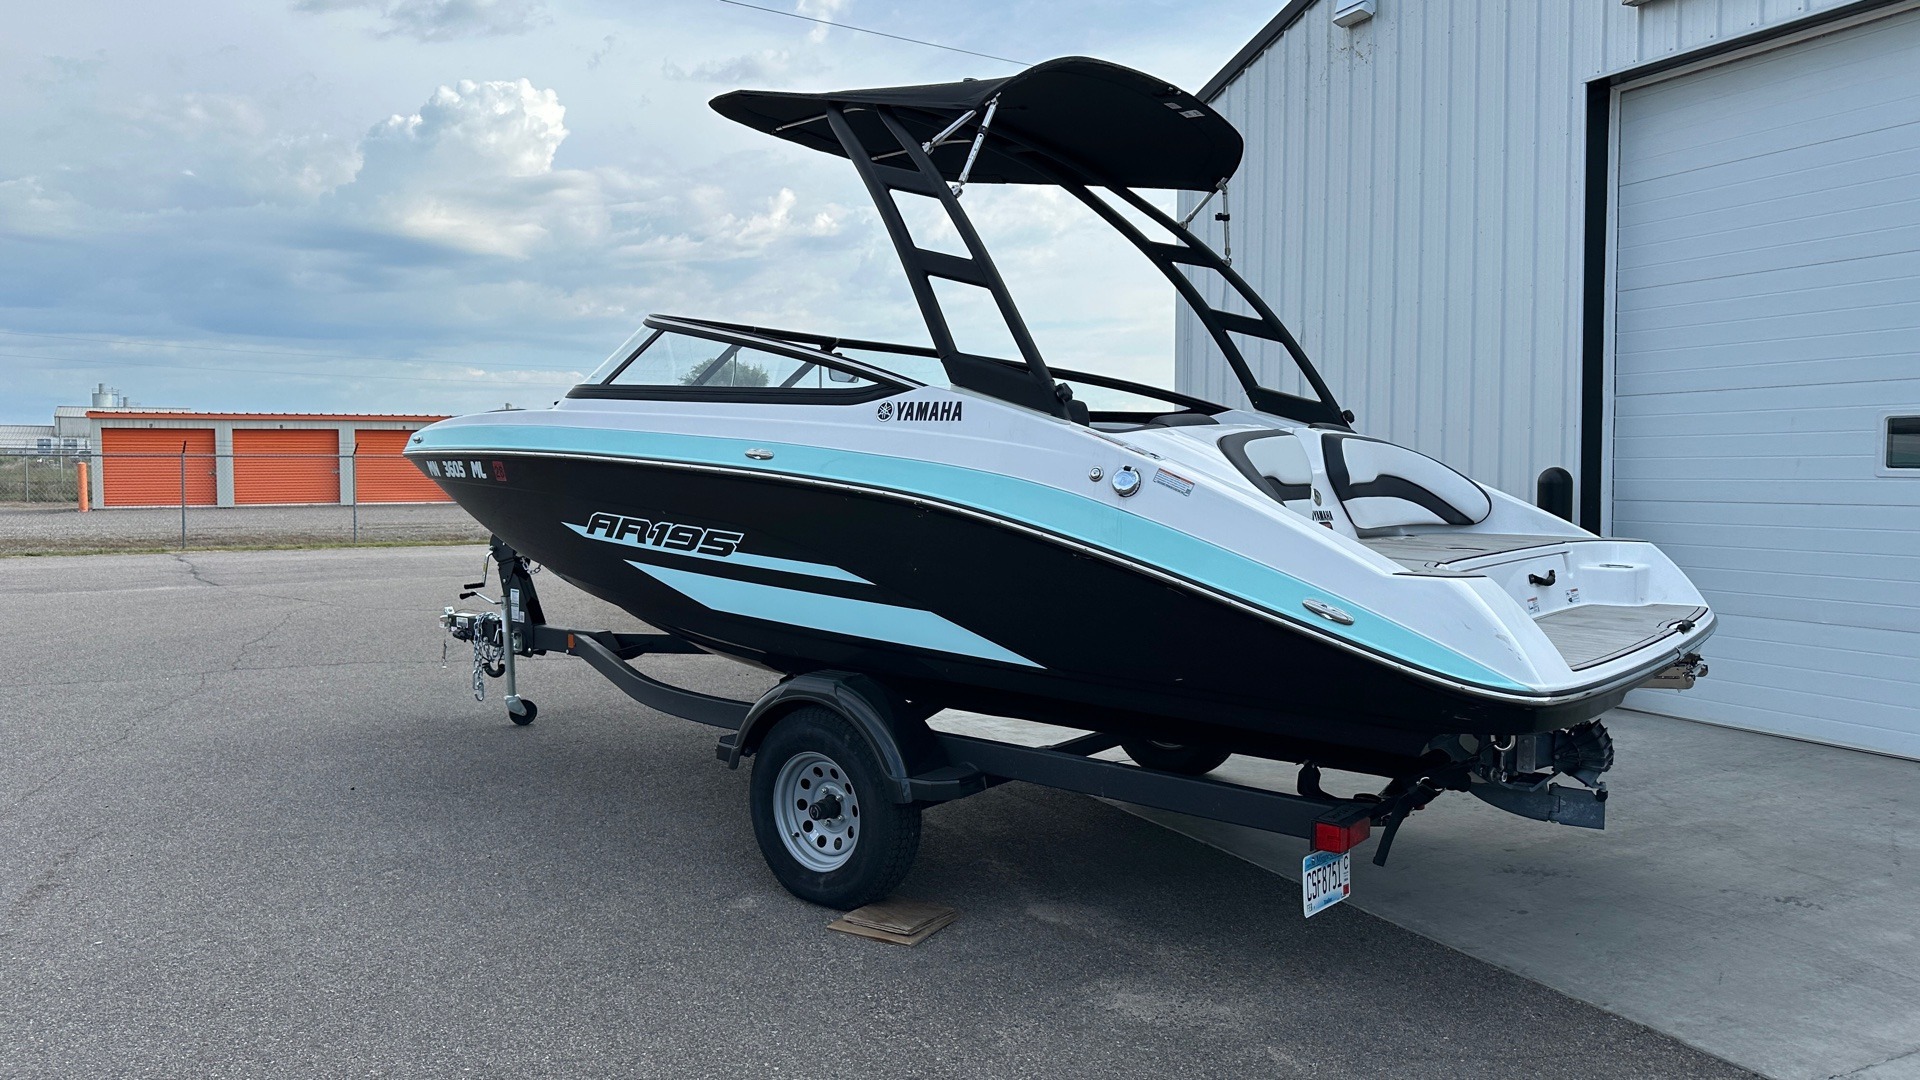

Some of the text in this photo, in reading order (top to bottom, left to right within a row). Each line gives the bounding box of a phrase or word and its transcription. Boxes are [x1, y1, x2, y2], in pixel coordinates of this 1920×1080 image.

[896, 401, 962, 421] YAMAHA
[426, 460, 487, 479] MN 3605 ML
[585, 511, 745, 557] AR195
[1306, 861, 1342, 901] CSF8751
